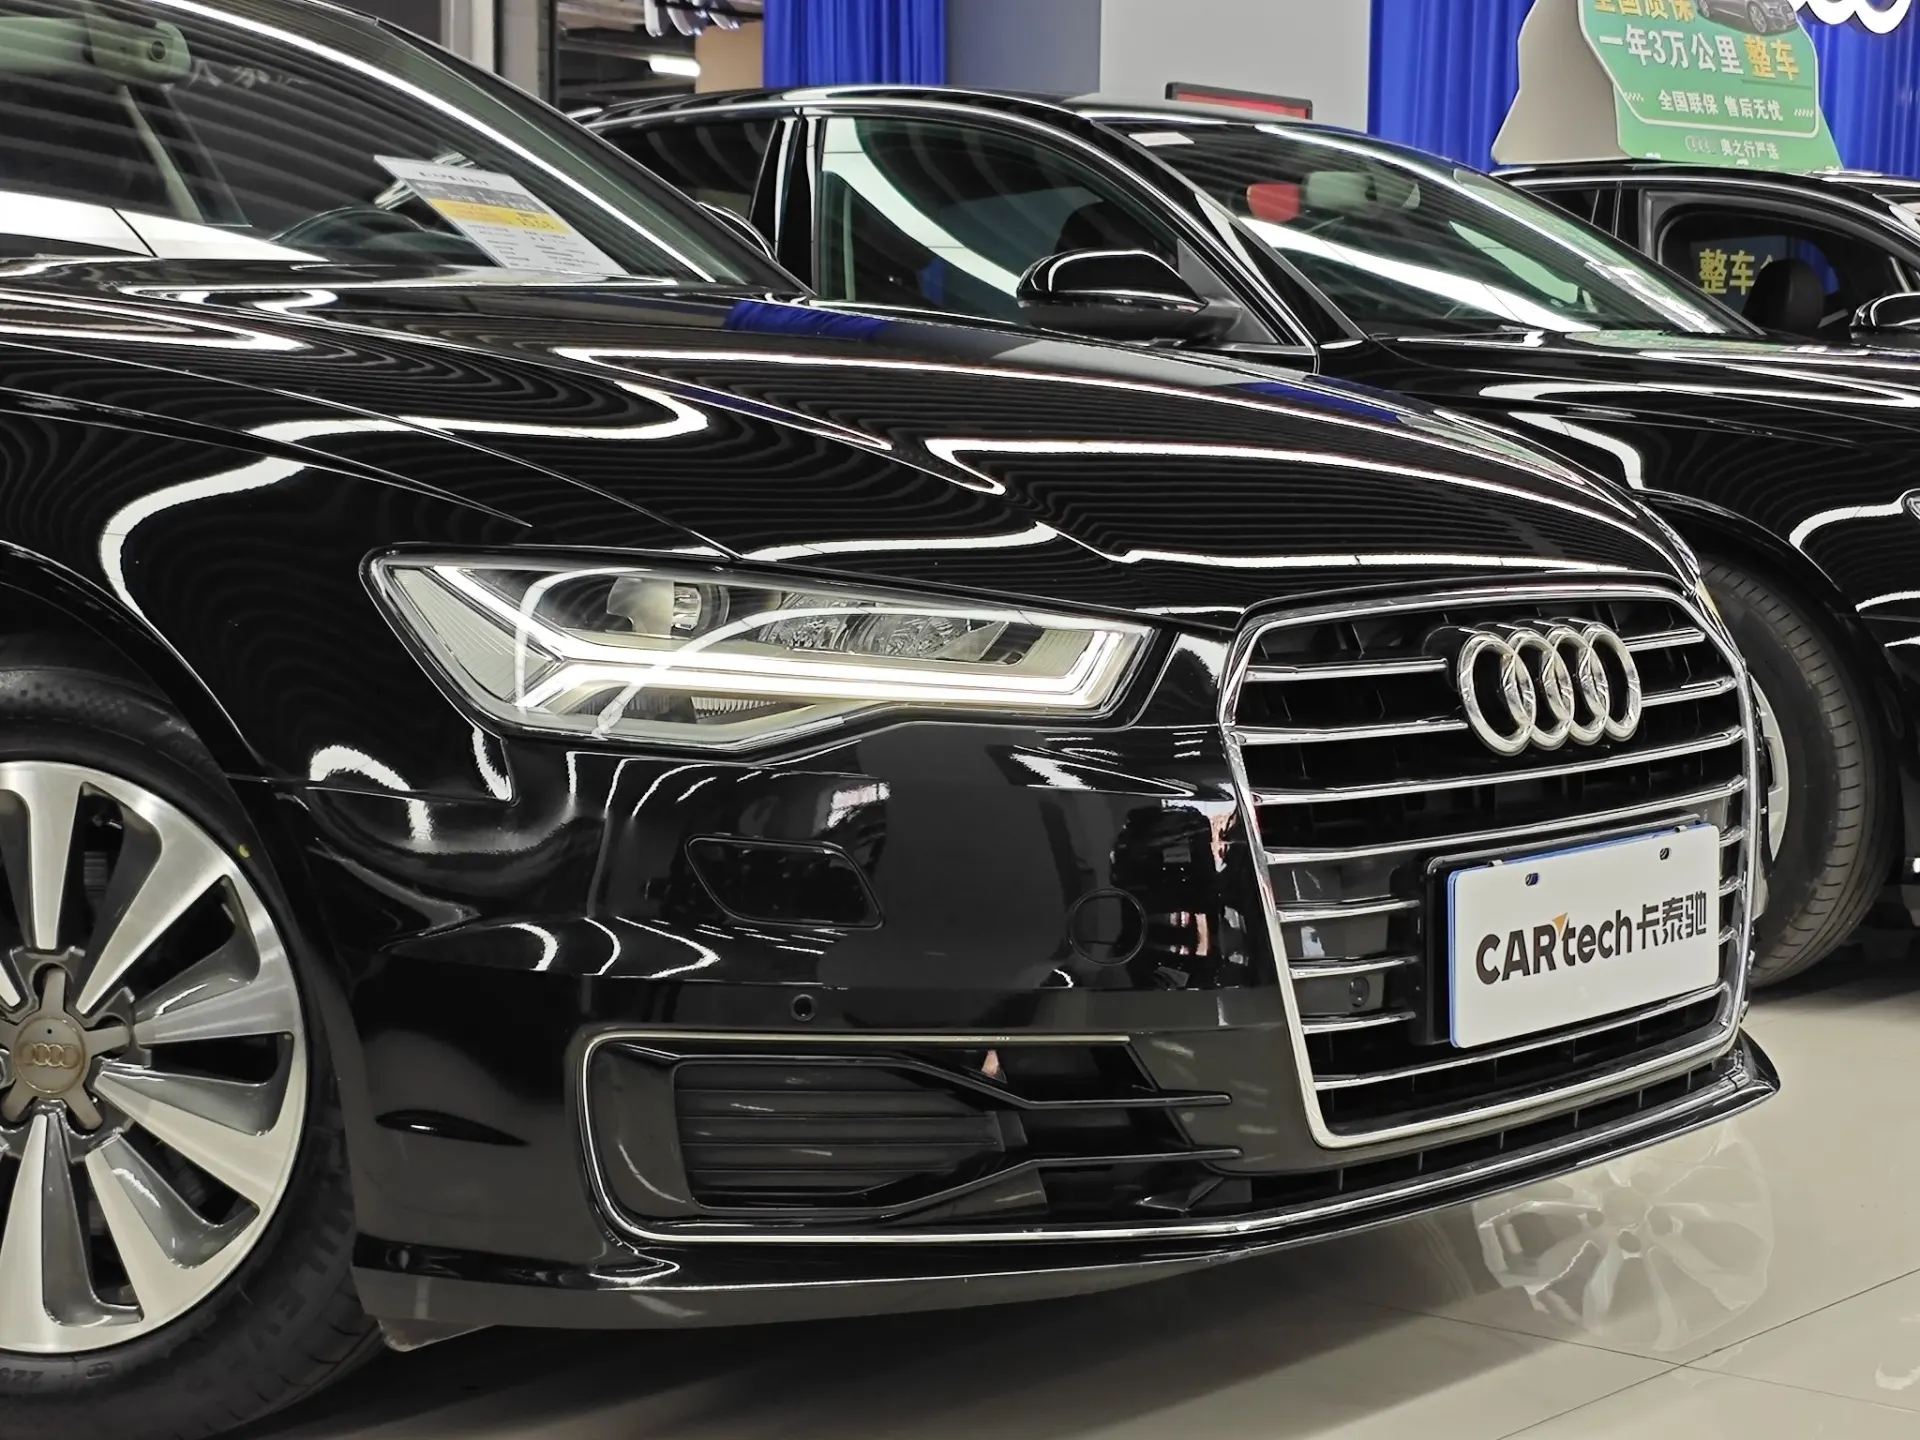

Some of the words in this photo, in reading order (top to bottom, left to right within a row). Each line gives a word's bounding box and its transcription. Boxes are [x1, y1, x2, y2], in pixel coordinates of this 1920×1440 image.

[1599, 24, 1744, 75] 一年3万公里
[1744, 34, 1800, 81] 整车
[1658, 89, 1719, 116] 全国联保
[1724, 95, 1784, 122] 售后无忧
[1698, 248, 1773, 296] 整车
[1475, 909, 1633, 986] CARtech
[1637, 890, 1707, 950] 卡泰驰
